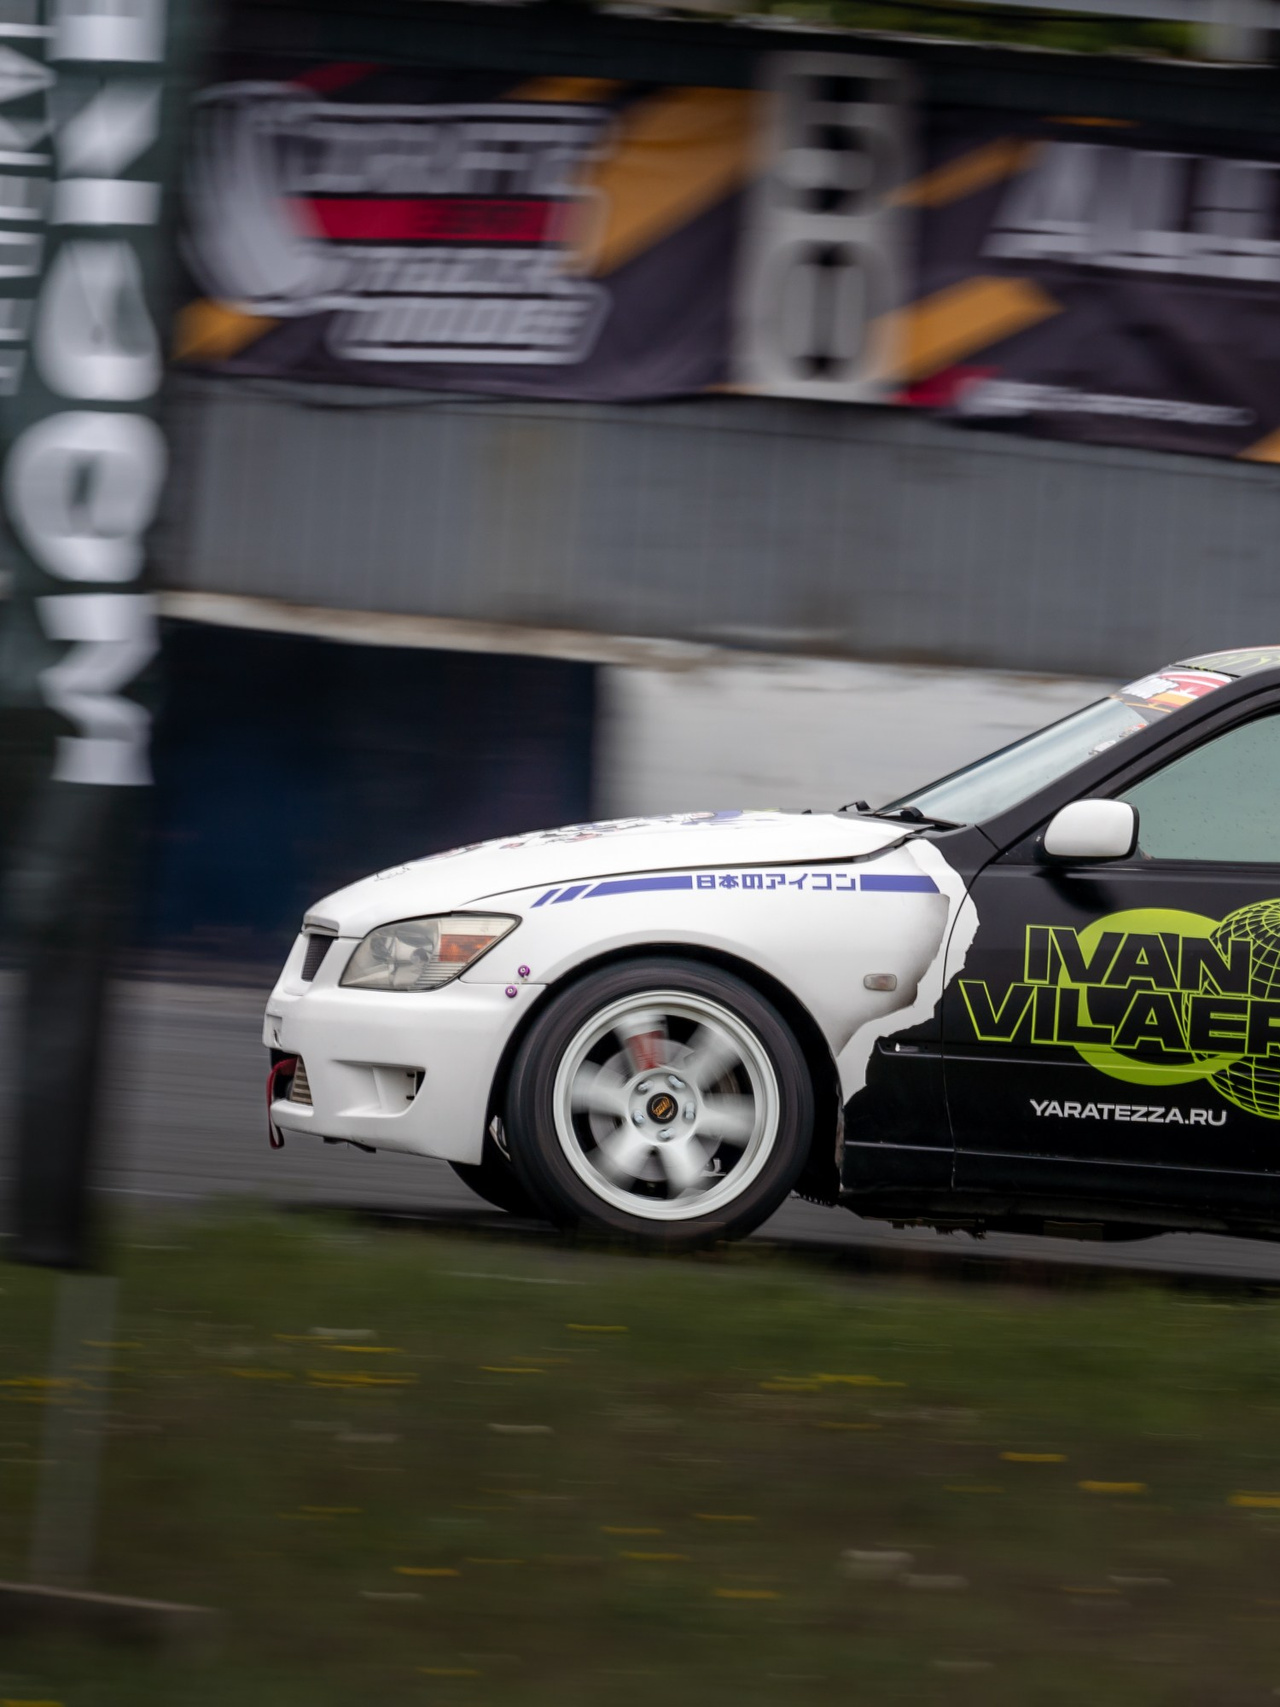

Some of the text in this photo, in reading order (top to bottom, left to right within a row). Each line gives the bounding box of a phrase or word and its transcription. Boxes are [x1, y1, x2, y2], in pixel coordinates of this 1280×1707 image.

[696, 873, 857, 891] 日本のアイコン
[1023, 924, 1254, 997] IVAN
[1030, 1099, 1227, 1126] YARATEZZA.RU
